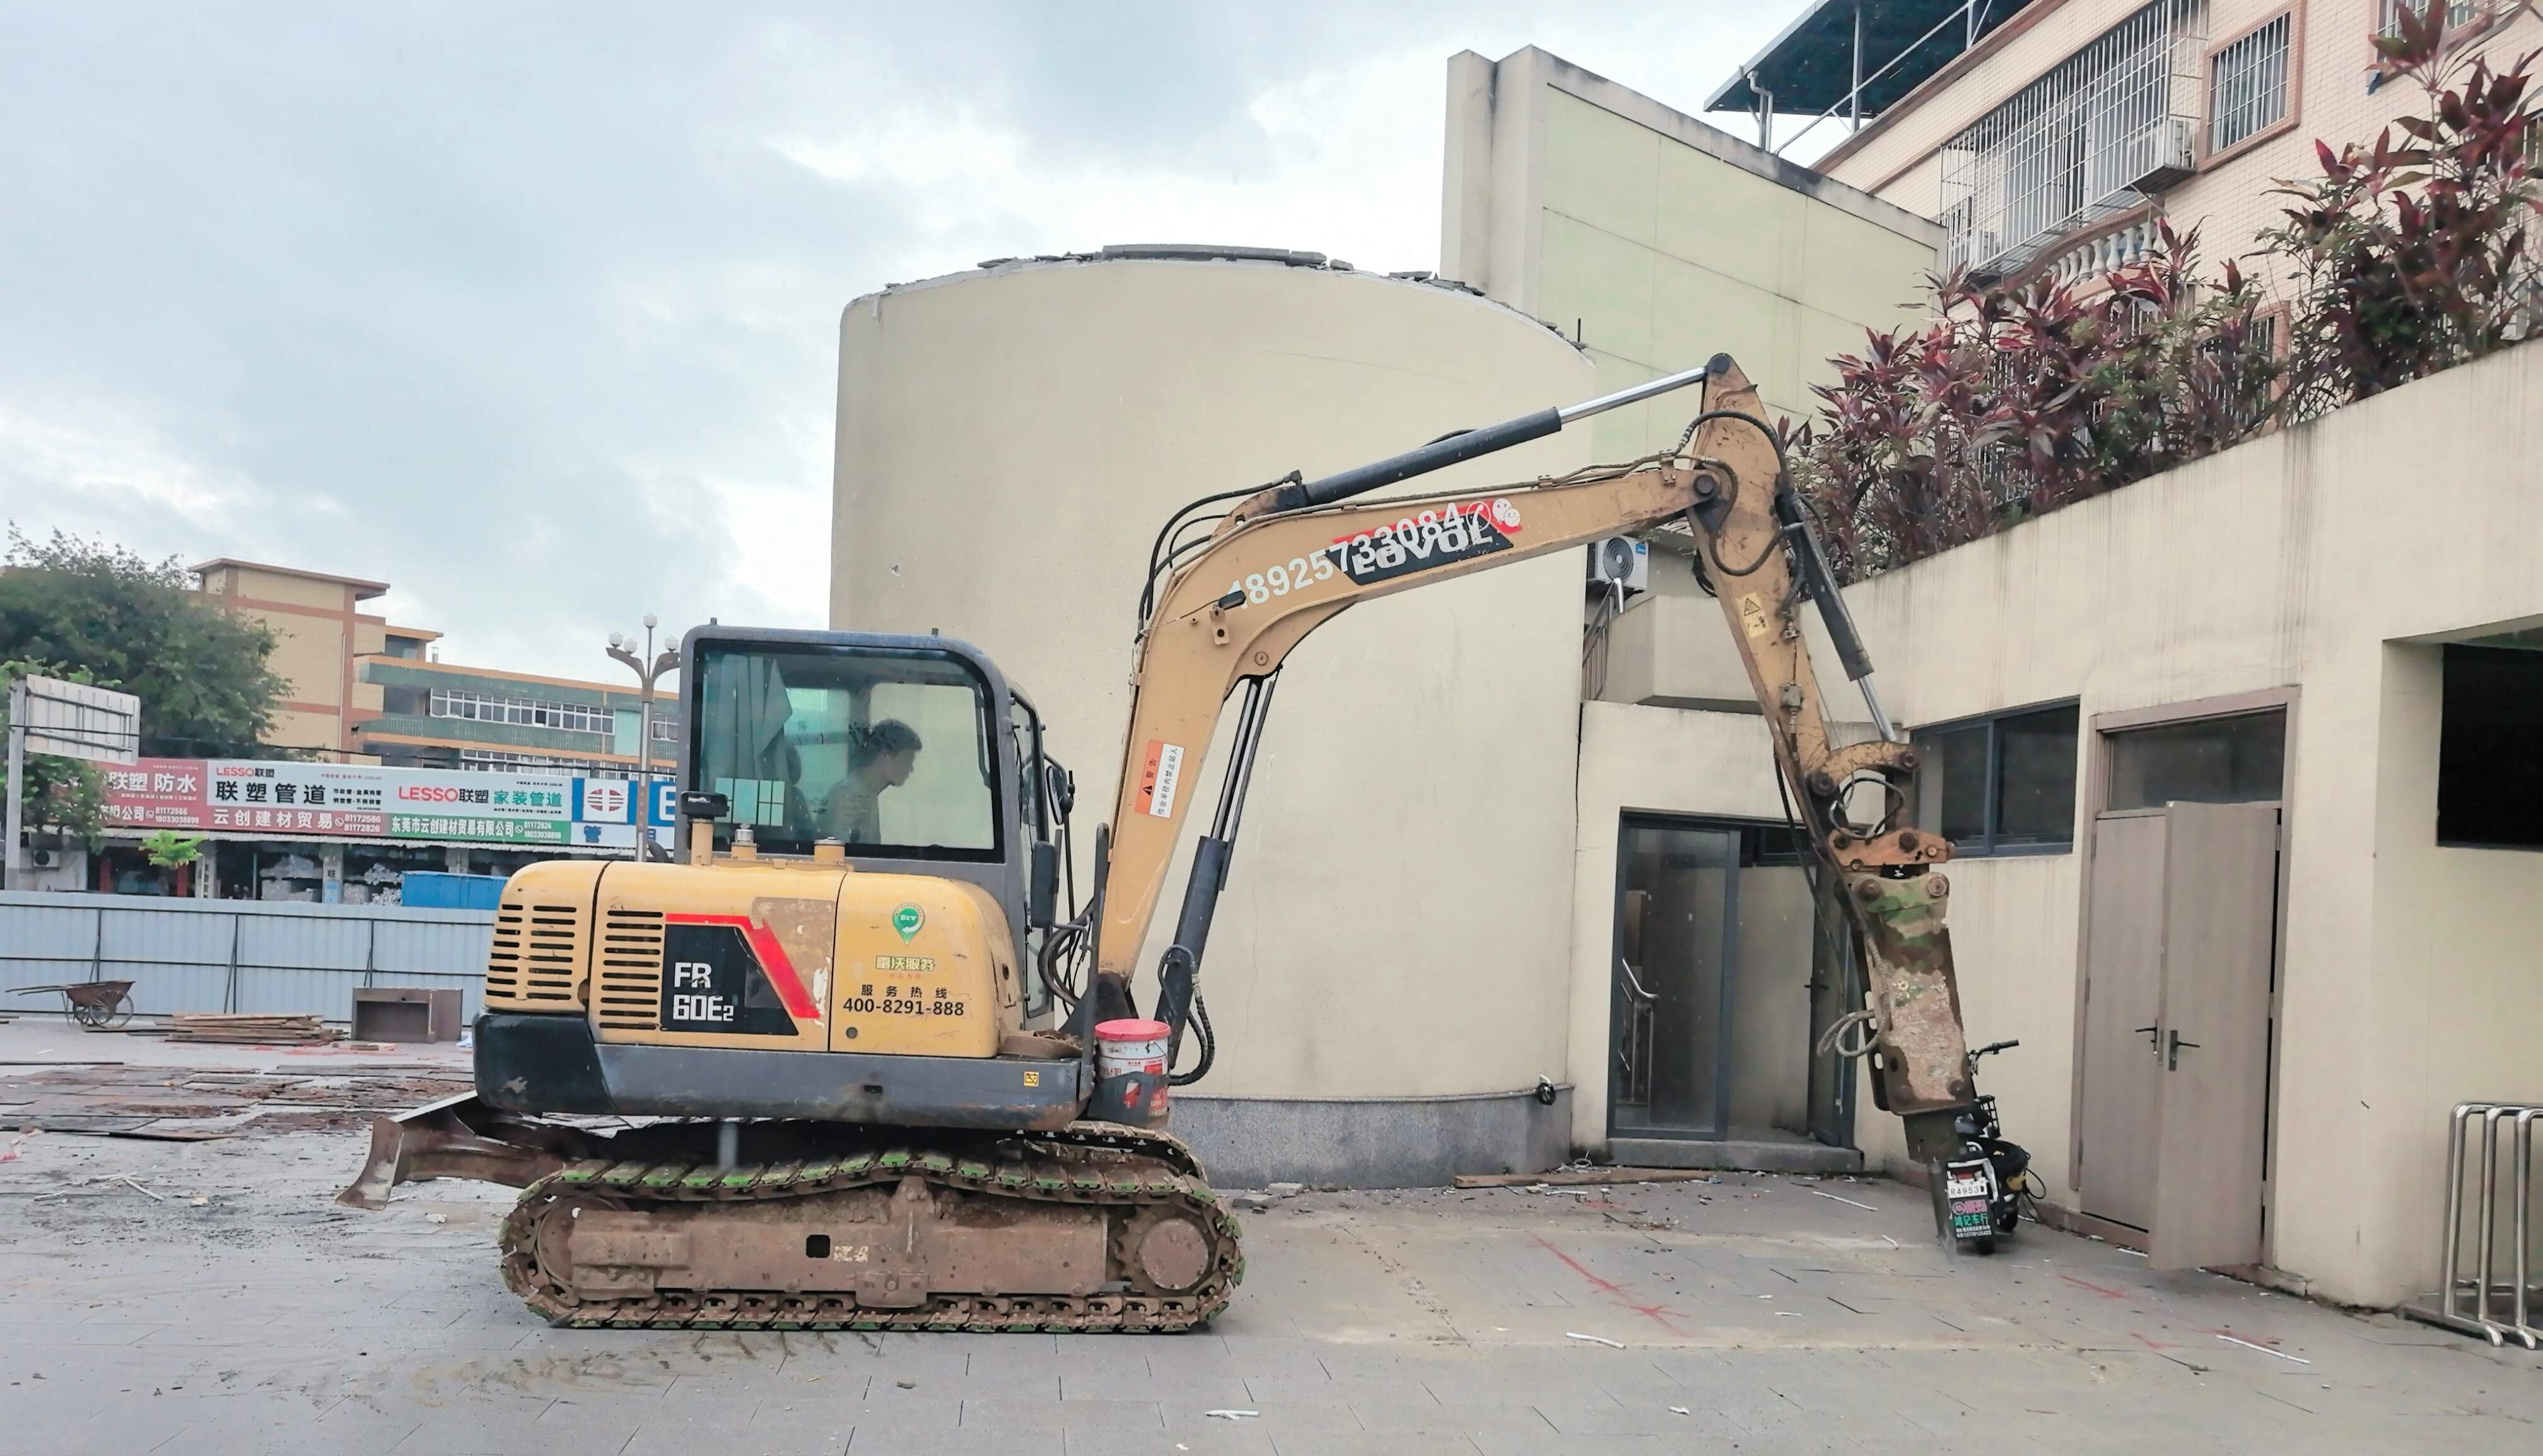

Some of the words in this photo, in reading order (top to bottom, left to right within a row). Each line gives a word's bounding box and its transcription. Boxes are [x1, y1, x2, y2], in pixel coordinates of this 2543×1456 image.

[154, 773, 197, 793] 防水
[216, 781, 325, 805] 联塑管道
[494, 790, 562, 807] 家装管道
[214, 808, 332, 829] 云创建材贸易
[344, 824, 380, 832] 81172826
[392, 816, 513, 837] 东莞市云创建材贸易有限公司
[876, 956, 935, 971] 雷沃服务
[674, 962, 712, 988] FR
[862, 984, 947, 999] 服务热线
[673, 994, 734, 1022] 60E2
[843, 998, 964, 1016] 400-8291-888
